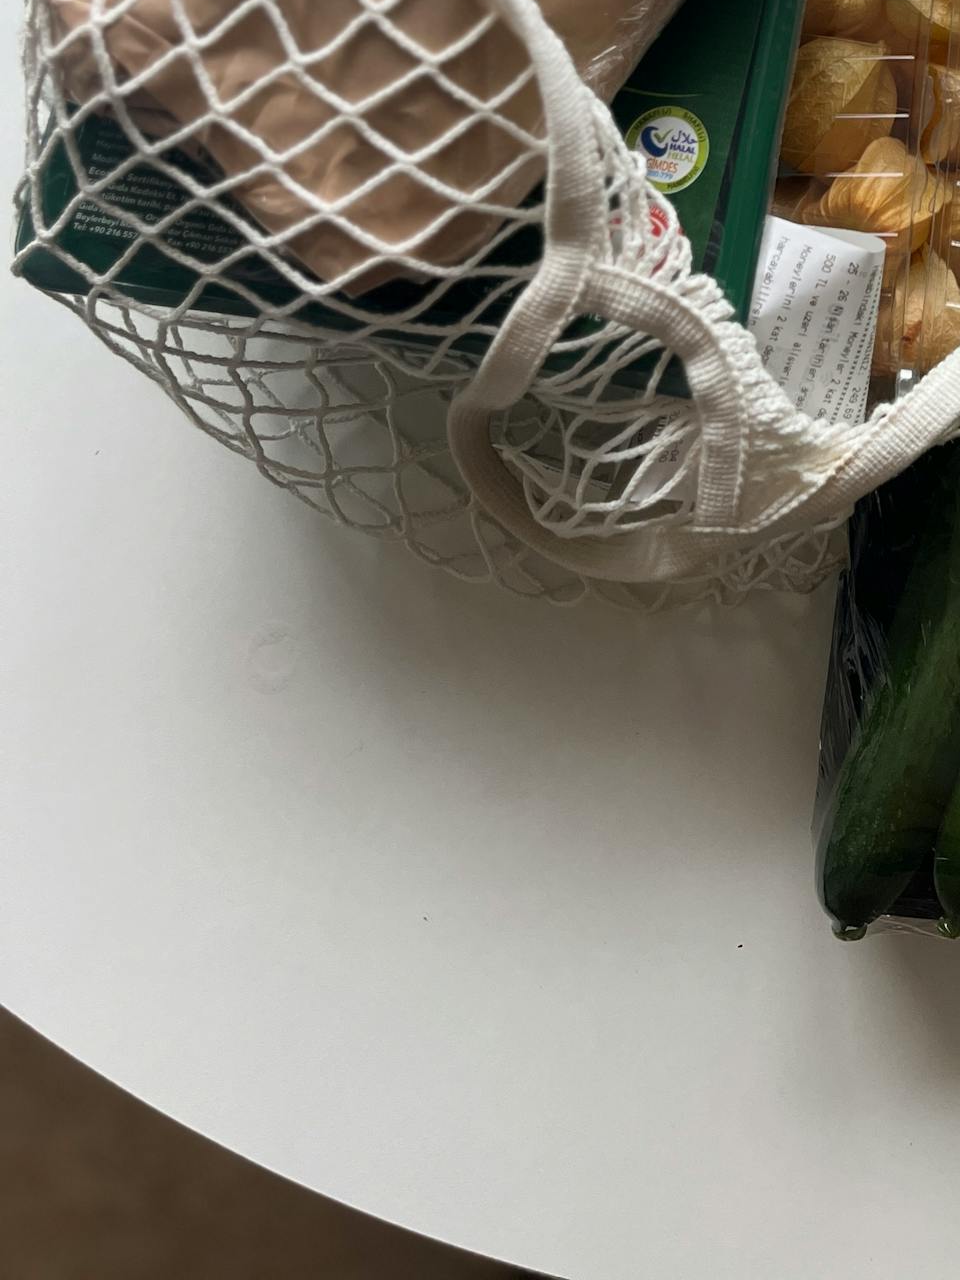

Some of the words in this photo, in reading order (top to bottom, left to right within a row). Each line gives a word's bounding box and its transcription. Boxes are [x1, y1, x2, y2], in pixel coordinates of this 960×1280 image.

[670, 144, 695, 154] HALAL
[73, 223, 87, 232] Tel:
[89, 225, 105, 234] +90
[106, 228, 121, 237] 216
[821, 254, 836, 274] 500
[846, 261, 860, 276] 25
[815, 278, 828, 292] TL
[809, 294, 820, 307] ve
[837, 289, 849, 303] 26
[776, 314, 787, 323] 2
[769, 326, 783, 342] kat
